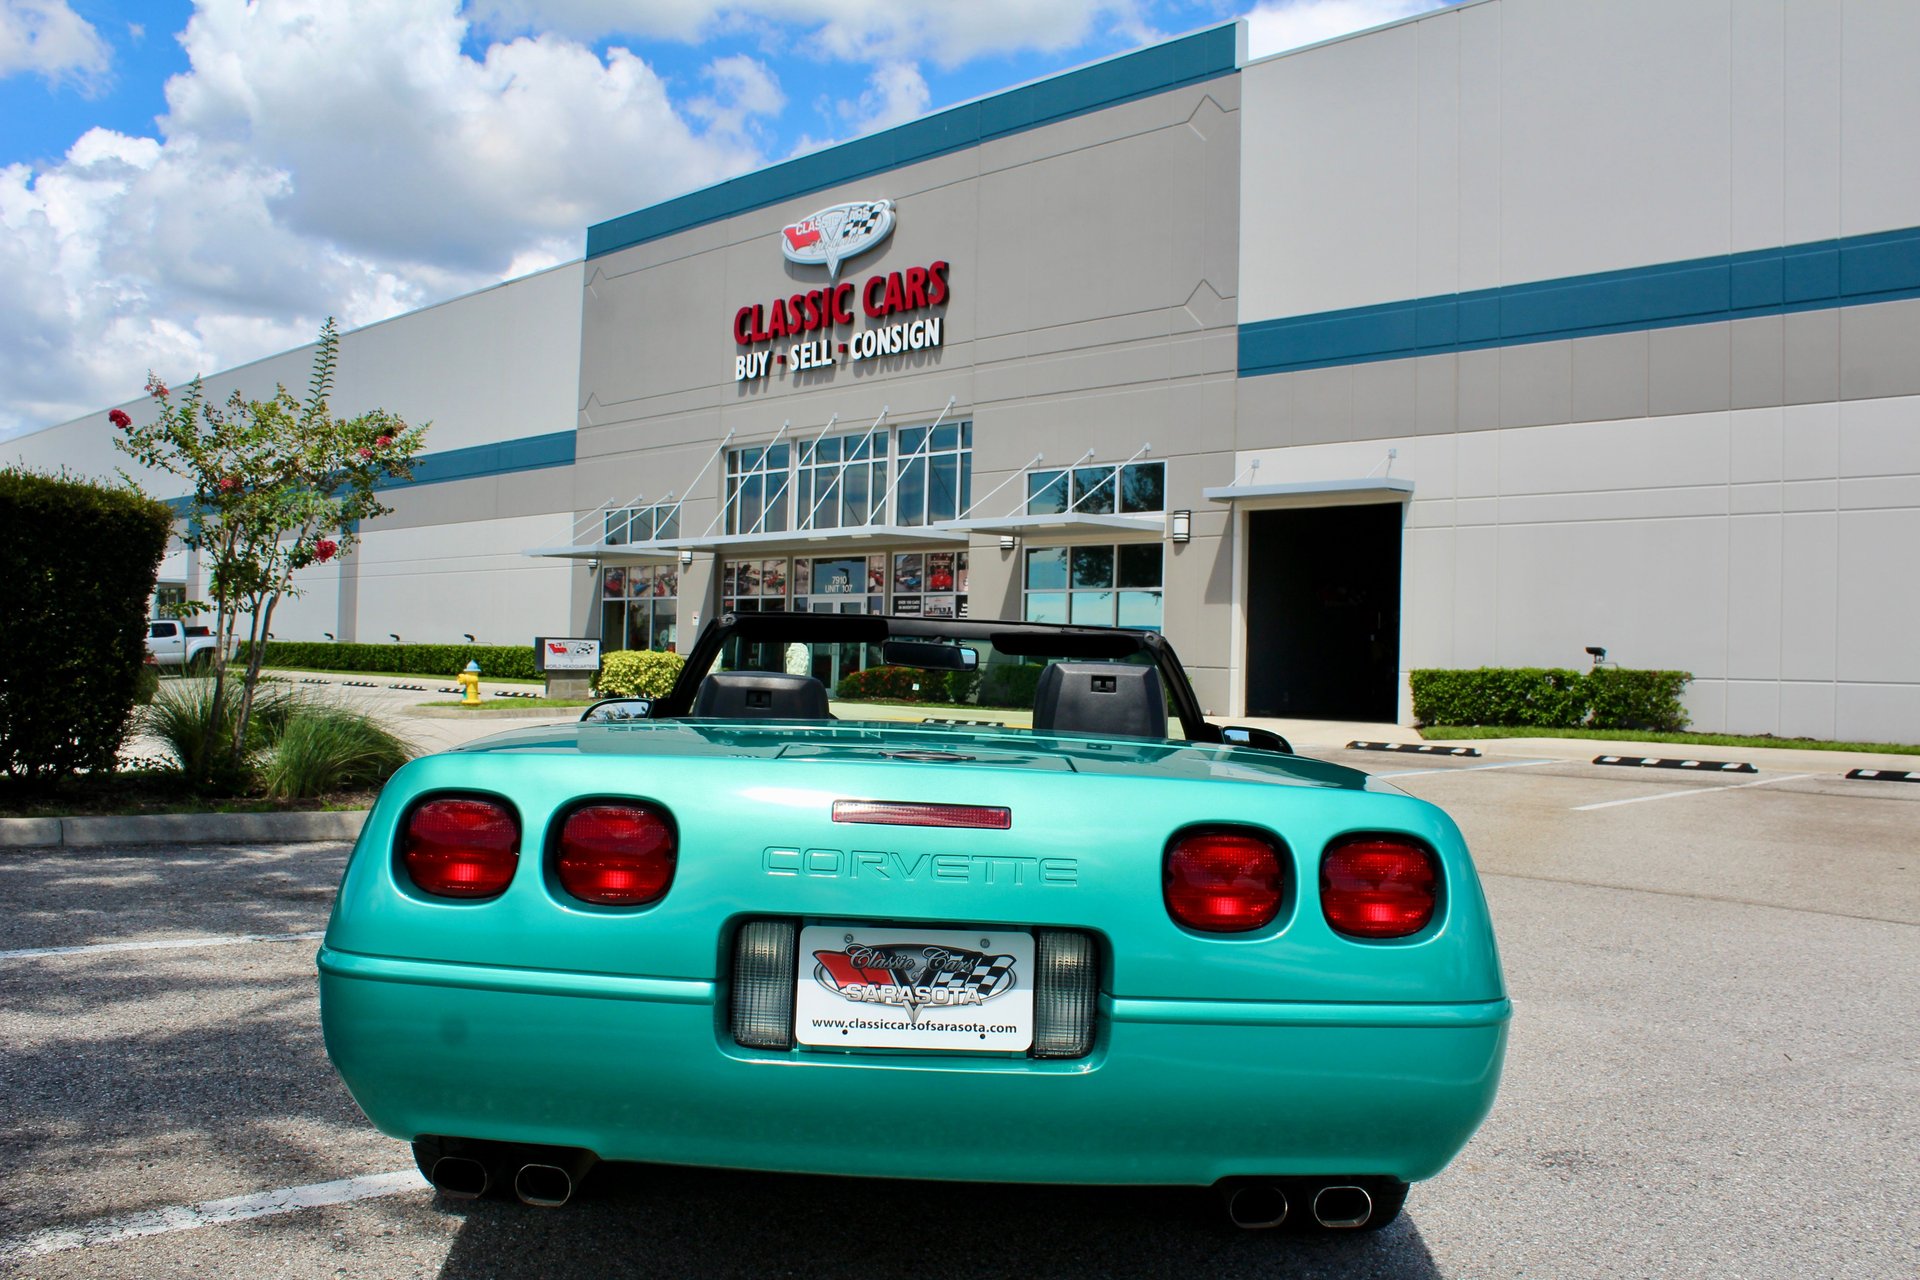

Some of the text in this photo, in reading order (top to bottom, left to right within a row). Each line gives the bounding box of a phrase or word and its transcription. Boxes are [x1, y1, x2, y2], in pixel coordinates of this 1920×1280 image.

[734, 261, 949, 345] CLASSIC CARS
[735, 317, 942, 381] BUY SELL CONSIGN
[824, 584, 853, 593] UNIT 107
[831, 575, 847, 584] 7910
[761, 845, 1078, 887] CORVETTE
[845, 943, 974, 972] Classic Cars
[845, 983, 982, 1006] SARASOTA
[811, 1017, 1018, 1034] www.classiccarsofsarasota.com
